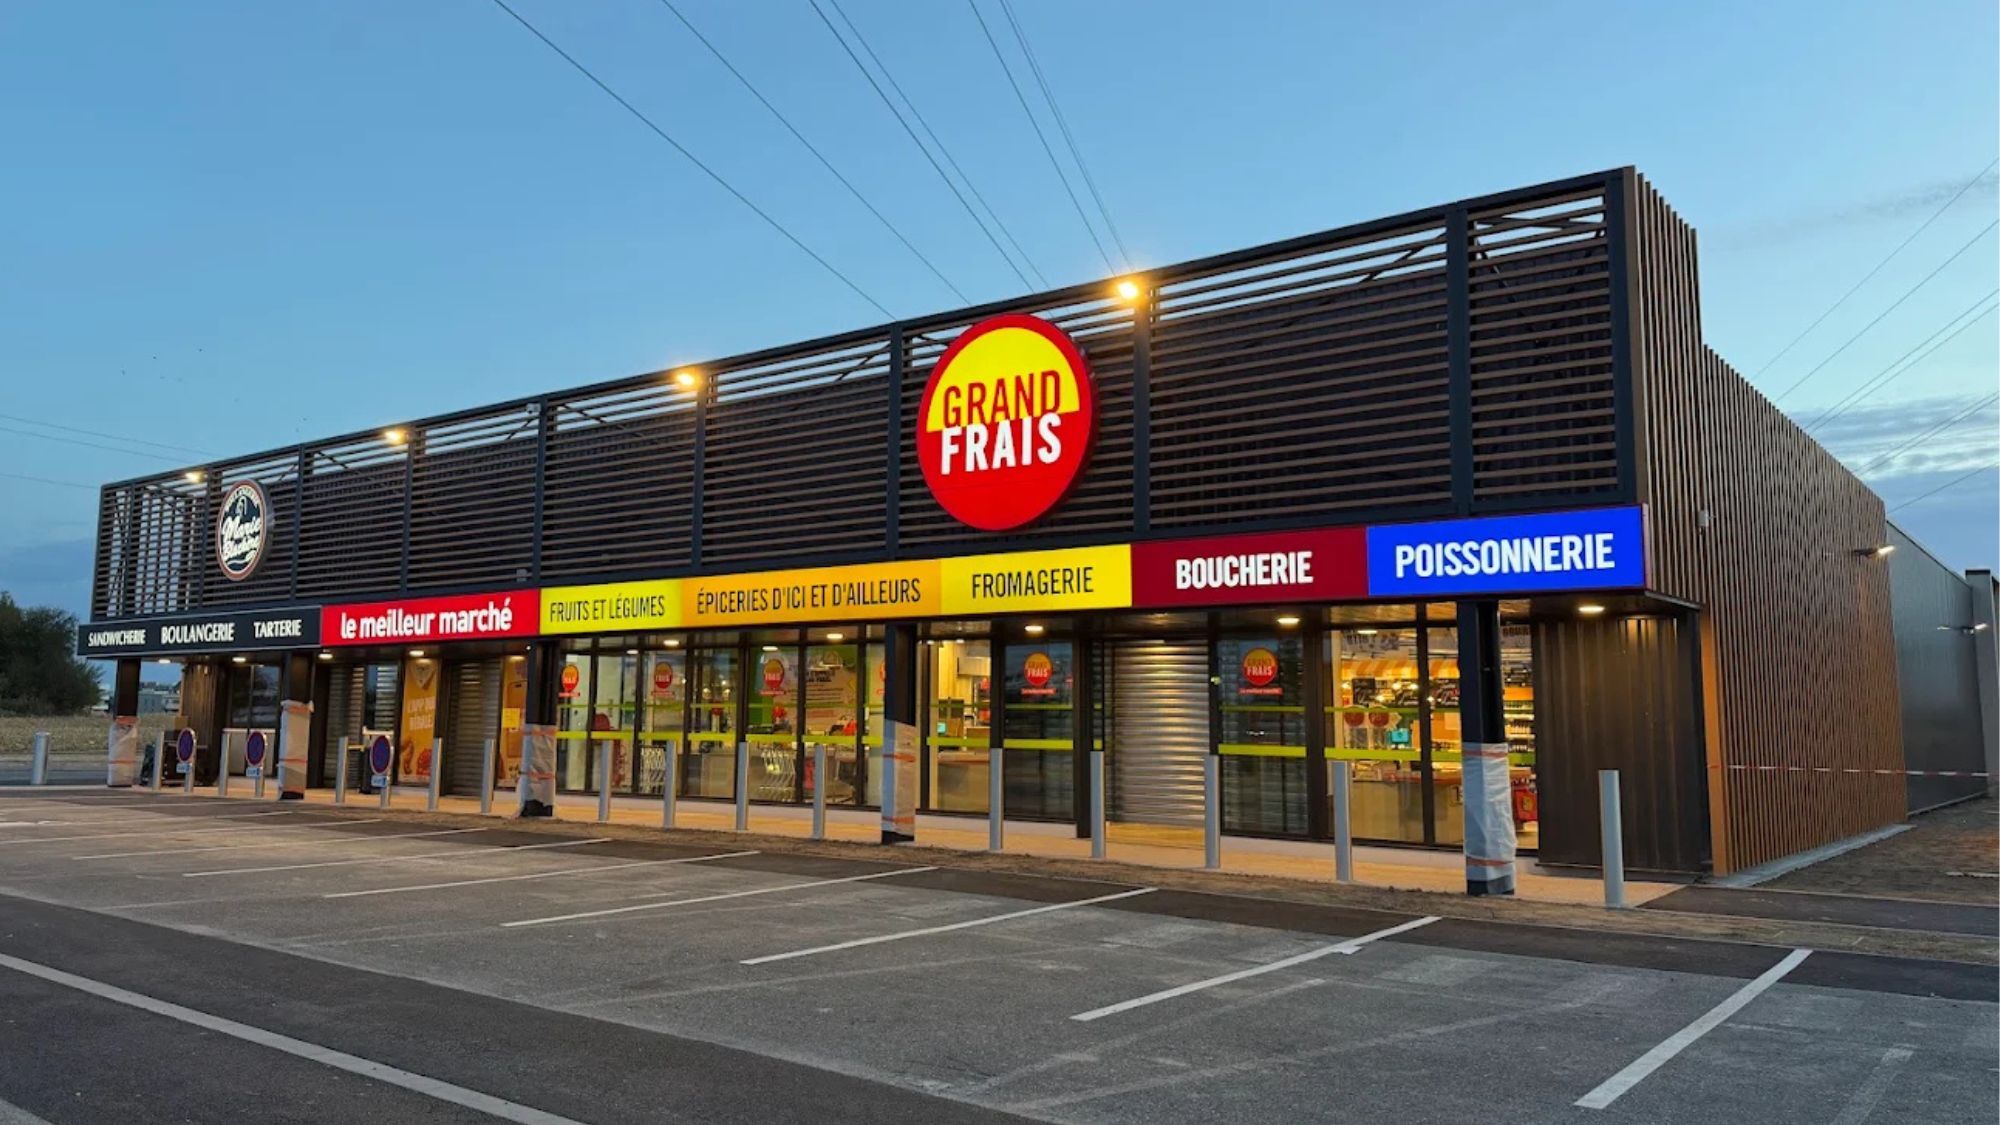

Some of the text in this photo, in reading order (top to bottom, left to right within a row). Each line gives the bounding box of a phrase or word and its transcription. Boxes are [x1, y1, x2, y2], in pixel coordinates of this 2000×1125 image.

[943, 369, 1061, 428] GRAND
[941, 412, 1062, 475] FRAIS
[1175, 550, 1314, 590] BOUCHERIE
[1395, 532, 1616, 579] POISSONNERIE
[696, 578, 921, 614] ÉPICERIES D'ICI ET D'AILLEURS
[971, 566, 1094, 599] FROMAGERIE
[340, 597, 513, 639] le meilleur marché
[549, 593, 665, 623] FRUITS ET LÉGUMES
[88, 629, 146, 647] SANDWICHERIE
[161, 623, 235, 644] BOULANGERIE
[254, 619, 302, 638] TARTERIE
